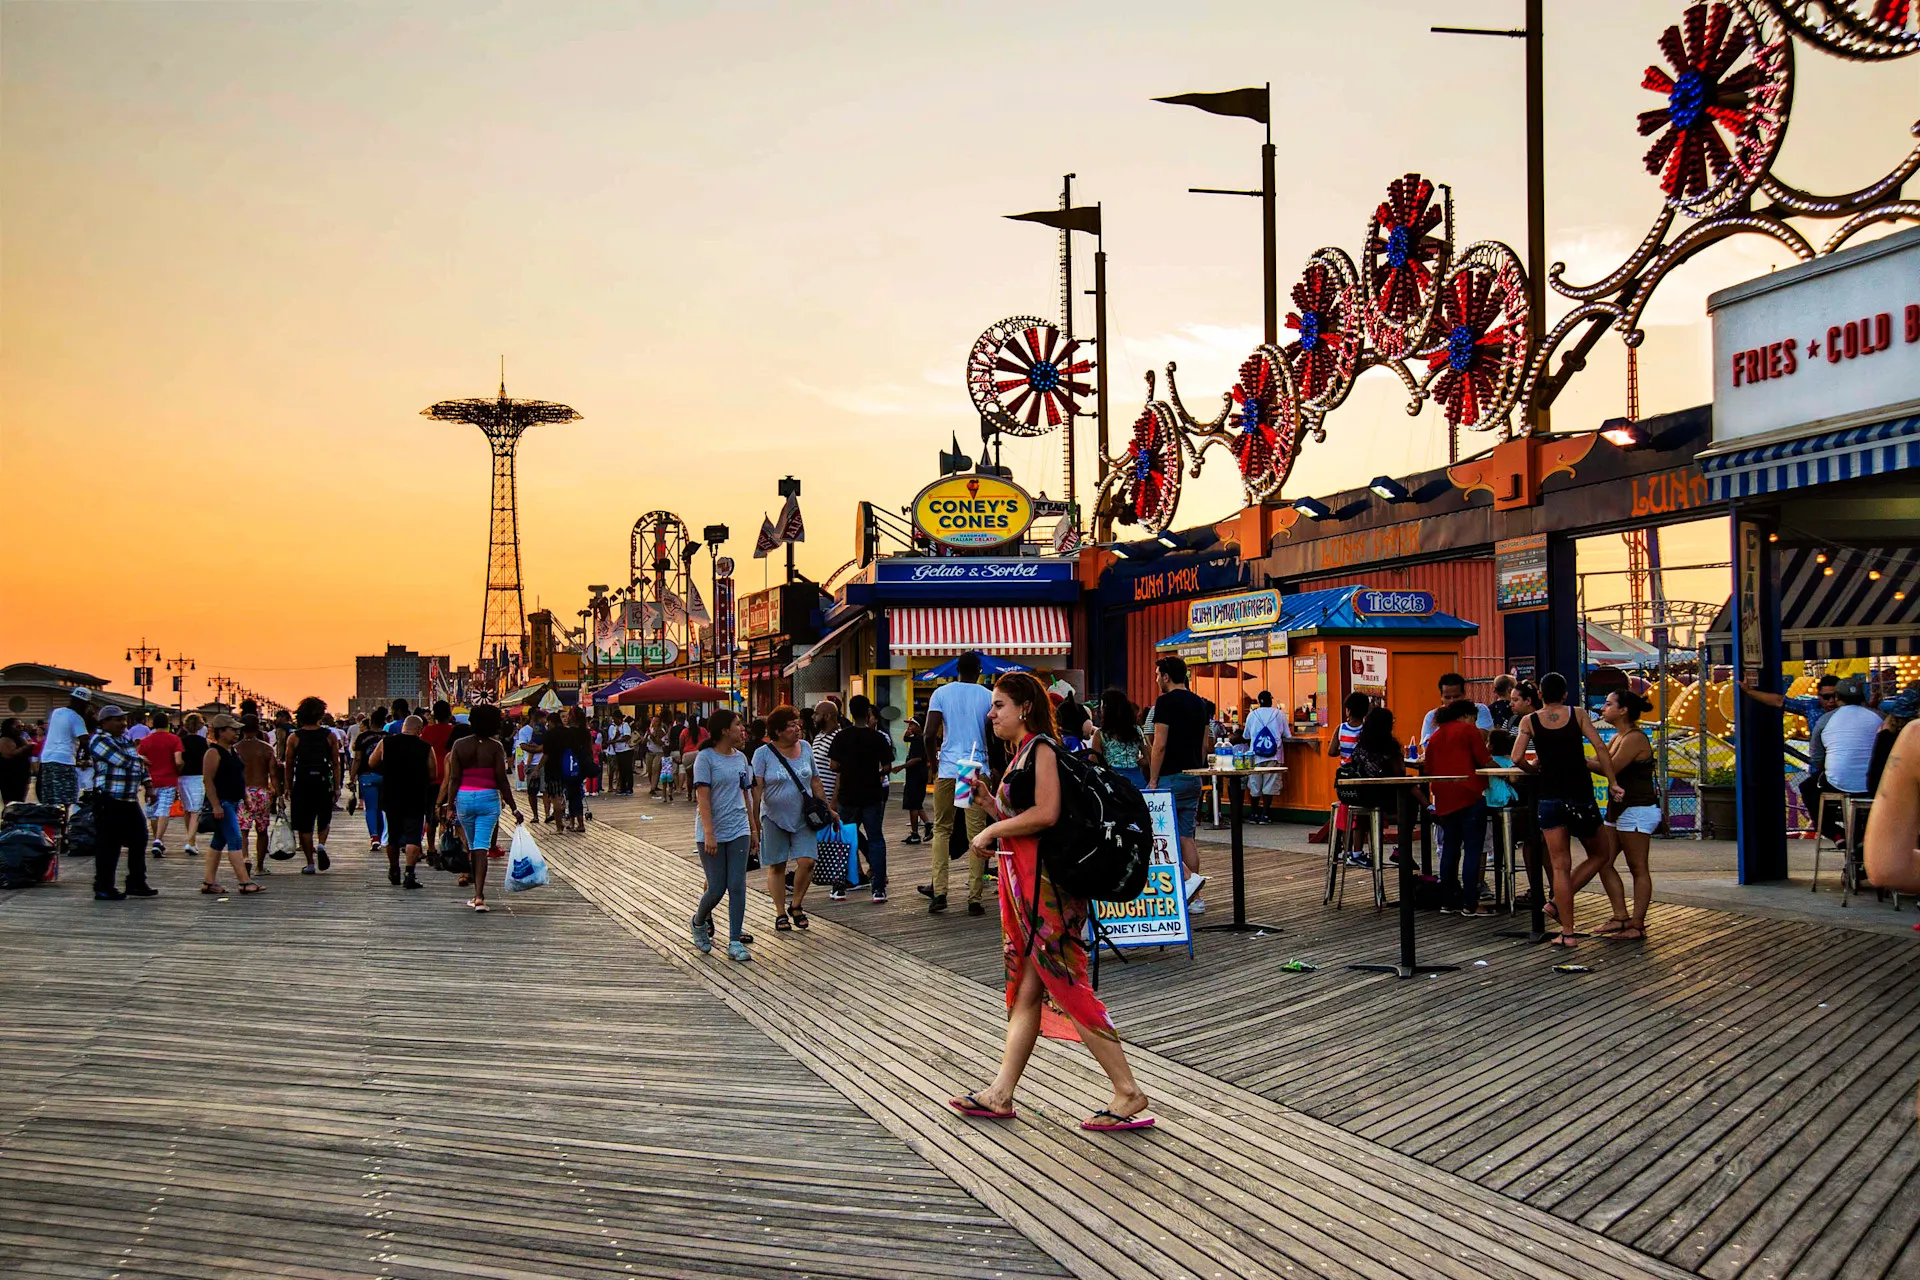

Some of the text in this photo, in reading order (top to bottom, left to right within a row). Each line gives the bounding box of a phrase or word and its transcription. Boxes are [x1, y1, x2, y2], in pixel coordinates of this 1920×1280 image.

[1732, 338, 1797, 387] FRIES
[1826, 313, 1891, 364] COLD
[929, 499, 1018, 514] CONEY'S
[938, 514, 1009, 529] CONES
[1320, 522, 1421, 569] LUNA PARK
[911, 563, 1039, 581] Gelato & Sorbet
[1134, 566, 1200, 601] LUNA PARK
[1192, 597, 1273, 625] LUNA PARK TICKETS
[1366, 592, 1425, 613] Tickets
[1256, 735, 1273, 749] 76
[1147, 801, 1167, 812] Best
[1096, 897, 1179, 920] DAUGHTER
[1138, 921, 1181, 933] ISLAND
